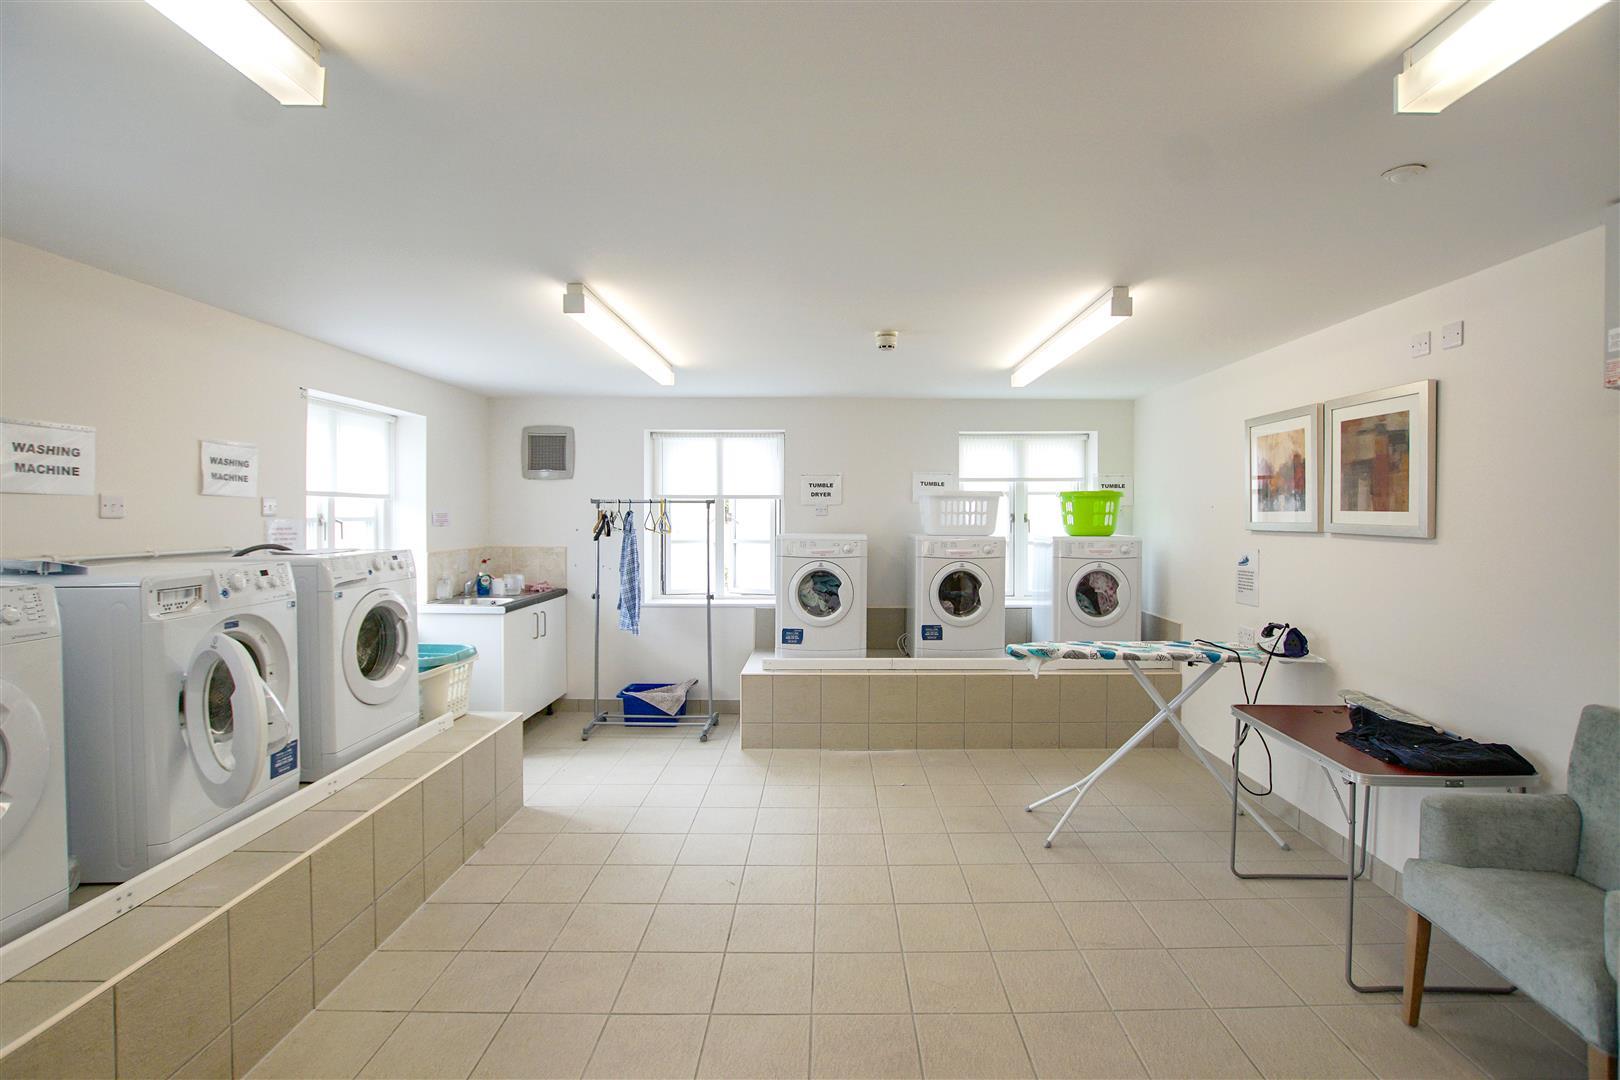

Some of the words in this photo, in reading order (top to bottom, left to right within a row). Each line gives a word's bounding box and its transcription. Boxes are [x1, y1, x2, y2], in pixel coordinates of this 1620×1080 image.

[12, 441, 81, 457] WASHING
[209, 456, 250, 468] WASHING
[14, 462, 80, 476] MACHINE
[210, 472, 249, 483] MACHINE
